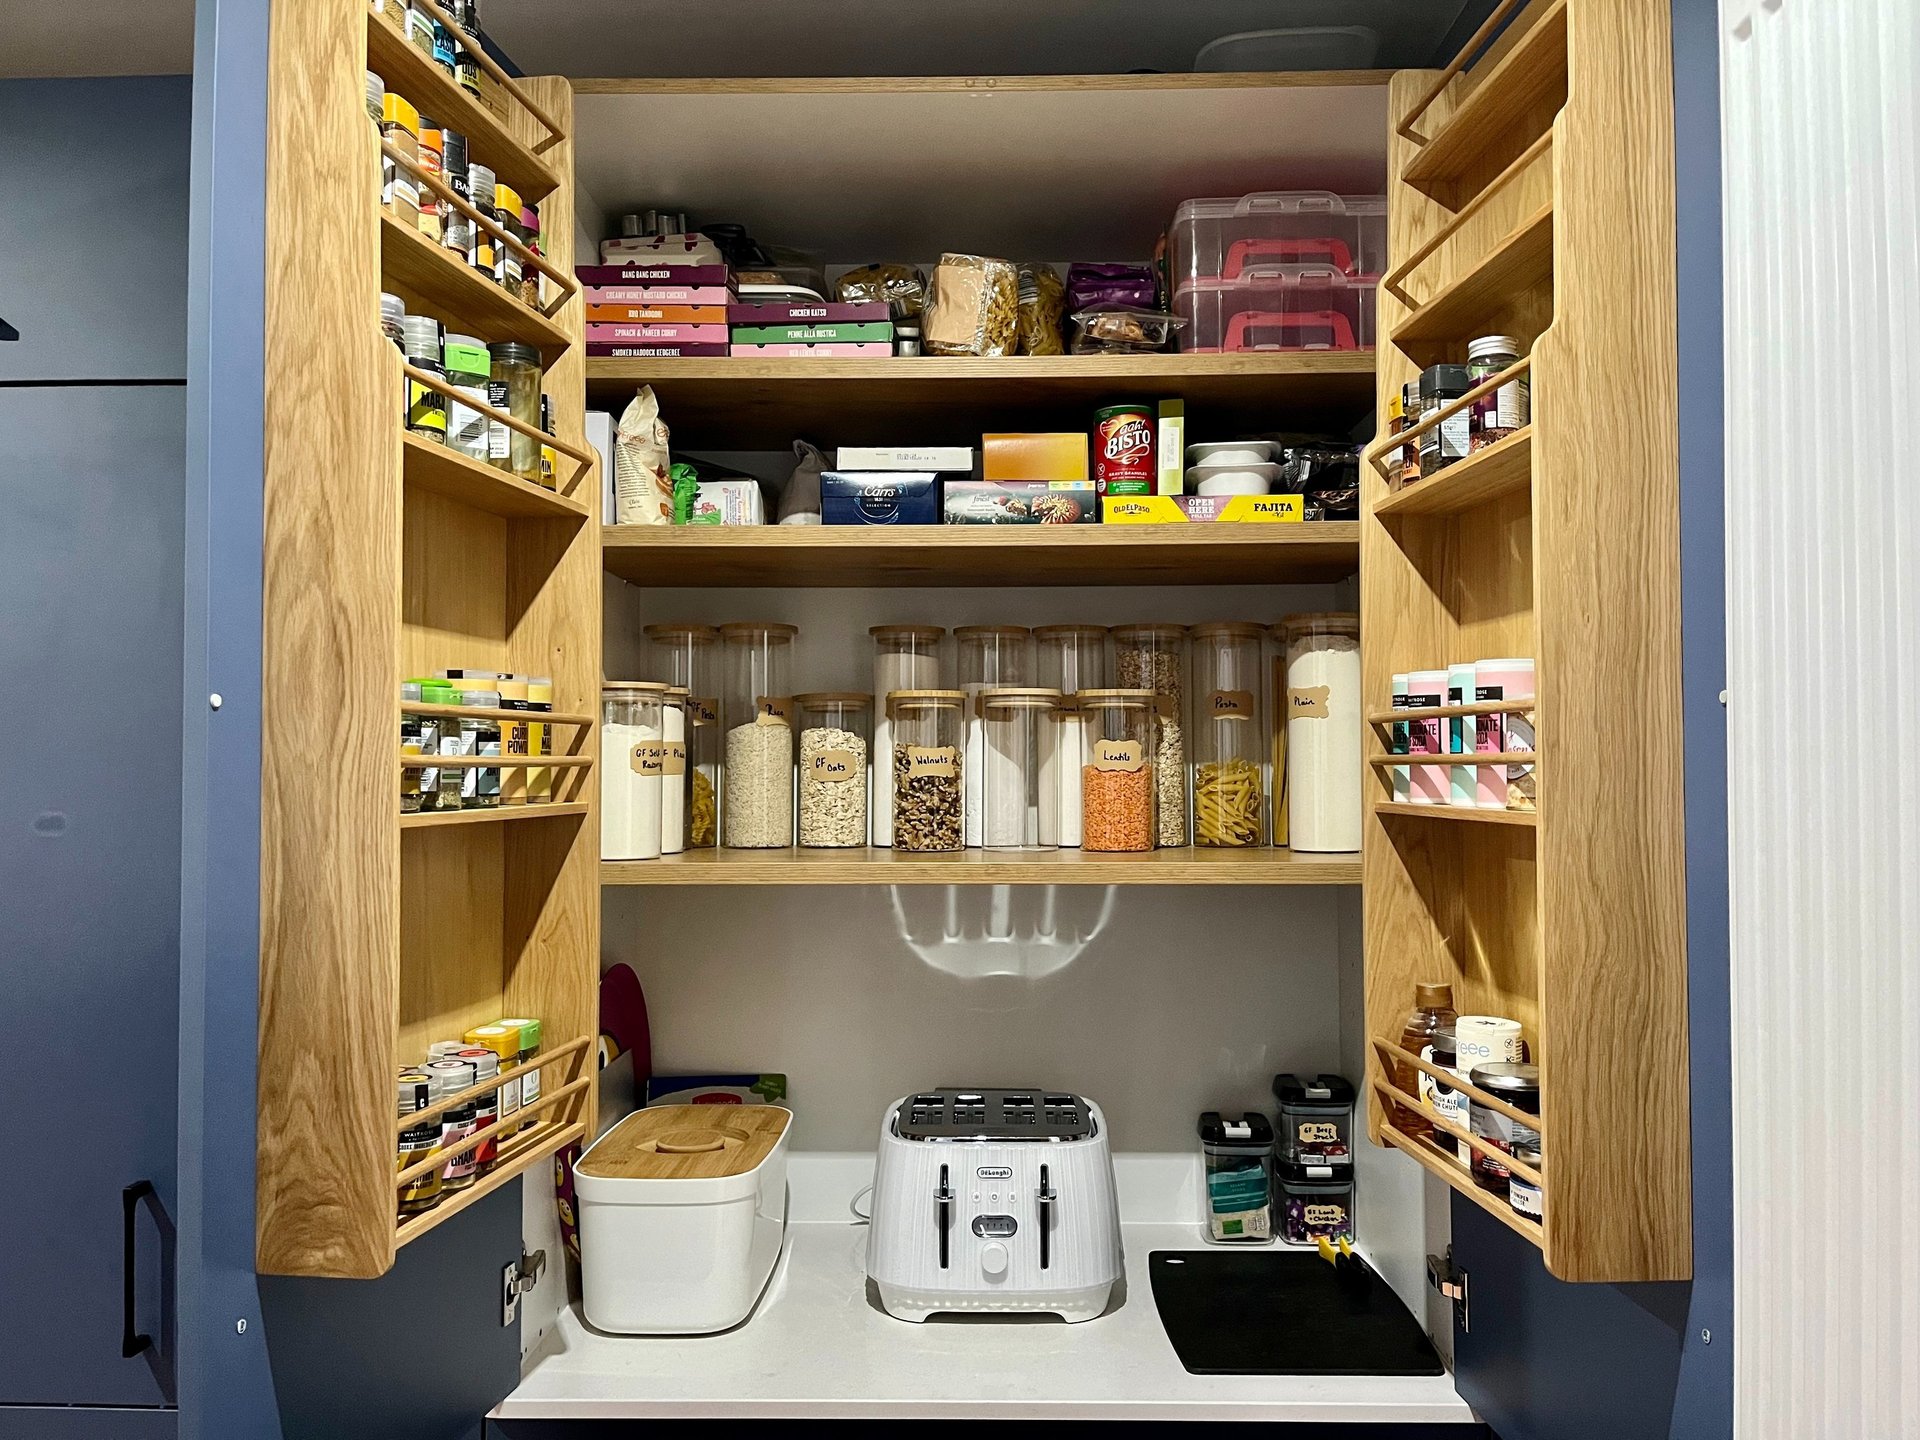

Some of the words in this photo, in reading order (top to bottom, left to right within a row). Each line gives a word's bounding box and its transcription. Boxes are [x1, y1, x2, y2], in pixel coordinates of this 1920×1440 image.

[622, 270, 635, 278] BANG
[636, 270, 649, 278] BANG
[650, 270, 670, 278] CHICKEN
[666, 291, 687, 299] CHICKEN
[614, 329, 636, 337] SPINACH
[642, 329, 661, 337] PANEER
[661, 329, 677, 337] CURRY
[788, 330, 803, 338] PENNE
[804, 330, 816, 338] ALLA
[612, 349, 632, 357] SMOKED
[633, 349, 656, 357] HADDOCK
[656, 349, 680, 357] KEDGEREE
[1107, 430, 1150, 459] BISTO
[1114, 504, 1126, 513] OLD
[1188, 506, 1214, 514] HERE
[1254, 504, 1293, 512] FAJITA
[765, 704, 784, 716] Rice
[916, 755, 948, 765] Walnuts
[1103, 750, 1131, 762] Lentils
[827, 763, 846, 772] Oats
